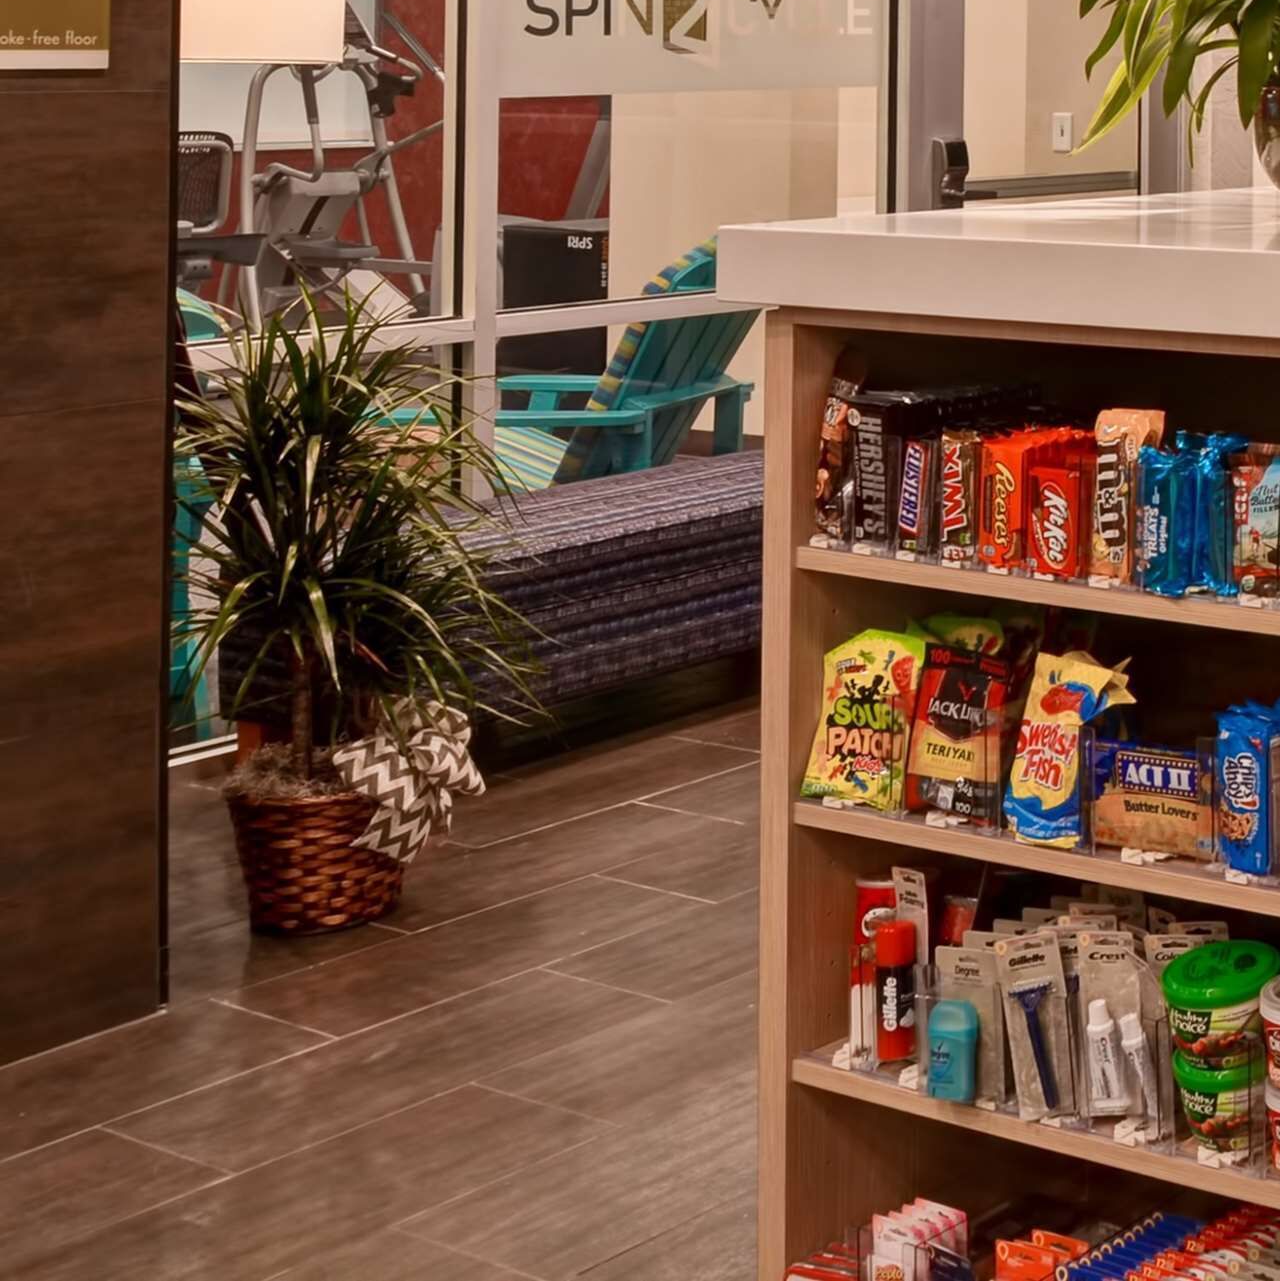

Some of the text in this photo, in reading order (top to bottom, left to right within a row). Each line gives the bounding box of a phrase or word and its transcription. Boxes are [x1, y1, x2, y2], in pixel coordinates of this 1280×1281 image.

[65, 30, 98, 46] floor
[827, 726, 901, 761] PATCH
[1125, 763, 1163, 791] ACT
[1123, 799, 1198, 822] Butter Lovers
[1008, 953, 1046, 968] Gillette
